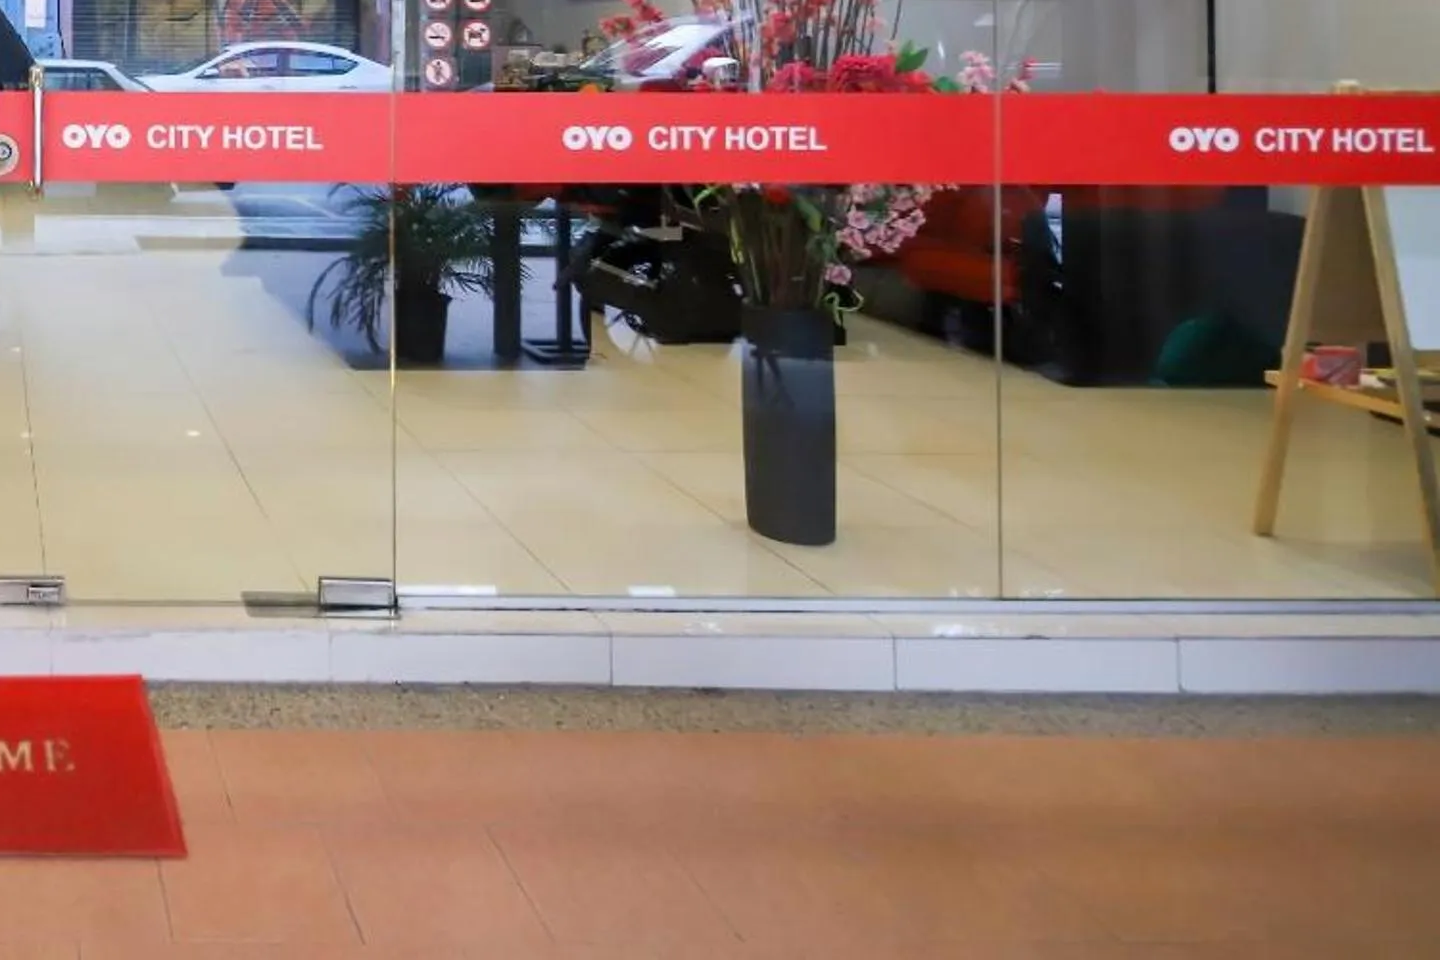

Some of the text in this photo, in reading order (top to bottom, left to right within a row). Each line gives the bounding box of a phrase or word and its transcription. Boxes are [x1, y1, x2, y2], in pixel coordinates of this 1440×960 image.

[61, 123, 325, 151] OYO CITY HOTEL
[561, 125, 827, 152] OYO CITY HOTEL
[1168, 126, 1435, 152] OYO CITY HOTEL
